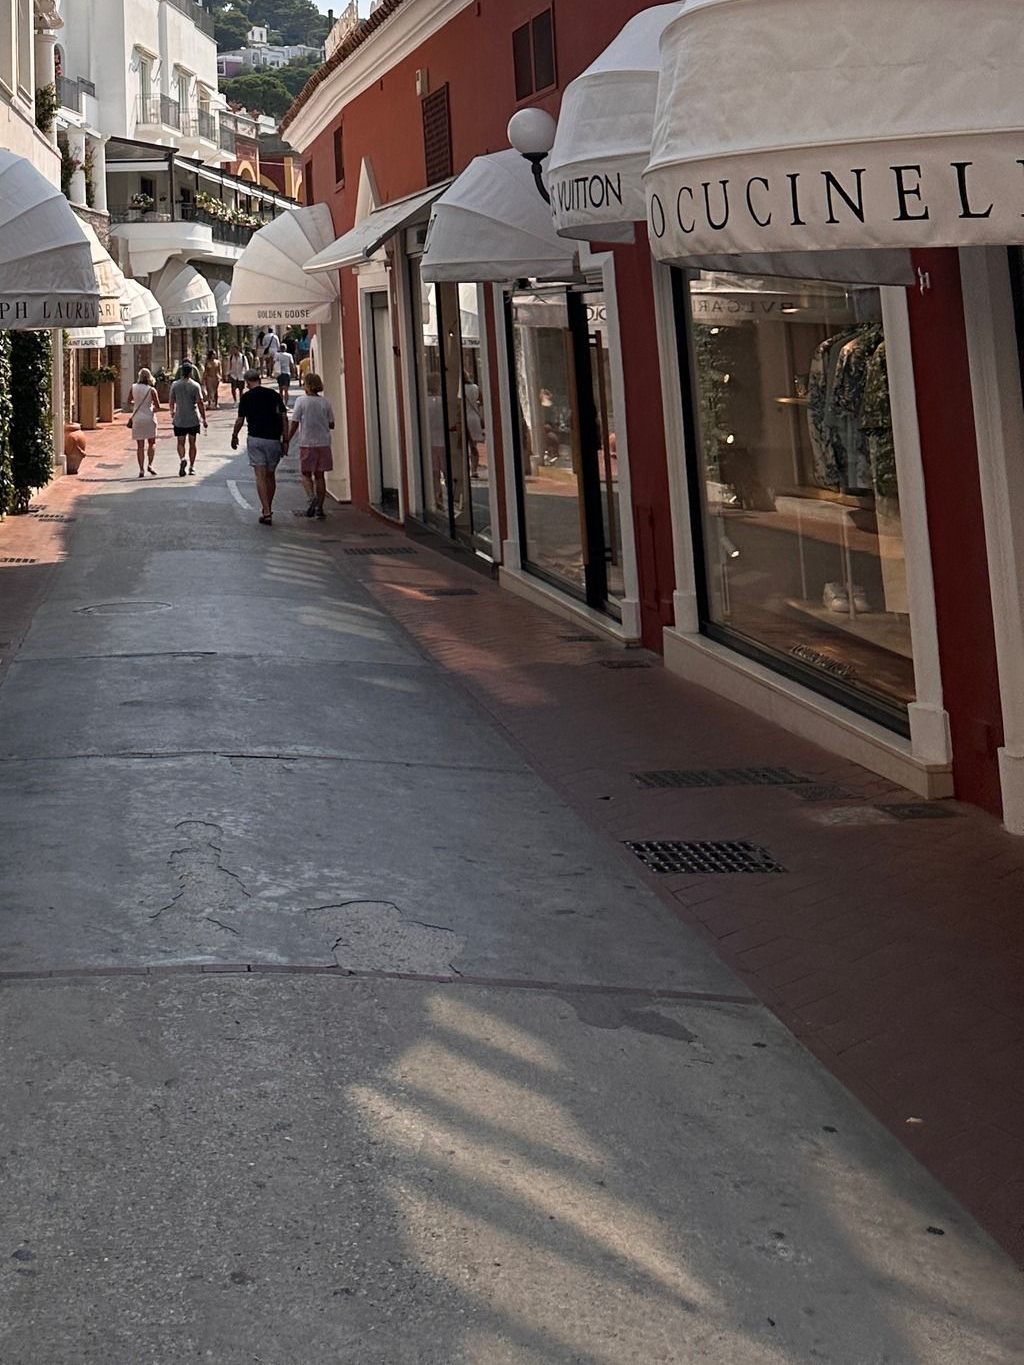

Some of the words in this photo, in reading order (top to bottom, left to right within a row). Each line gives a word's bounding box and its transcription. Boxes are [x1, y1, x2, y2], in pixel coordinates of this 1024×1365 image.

[557, 171, 623, 213] VUITTON
[676, 159, 1024, 234] CUCINEL
[257, 309, 282, 319] GOLDEN
[284, 309, 310, 319] GOOSE
